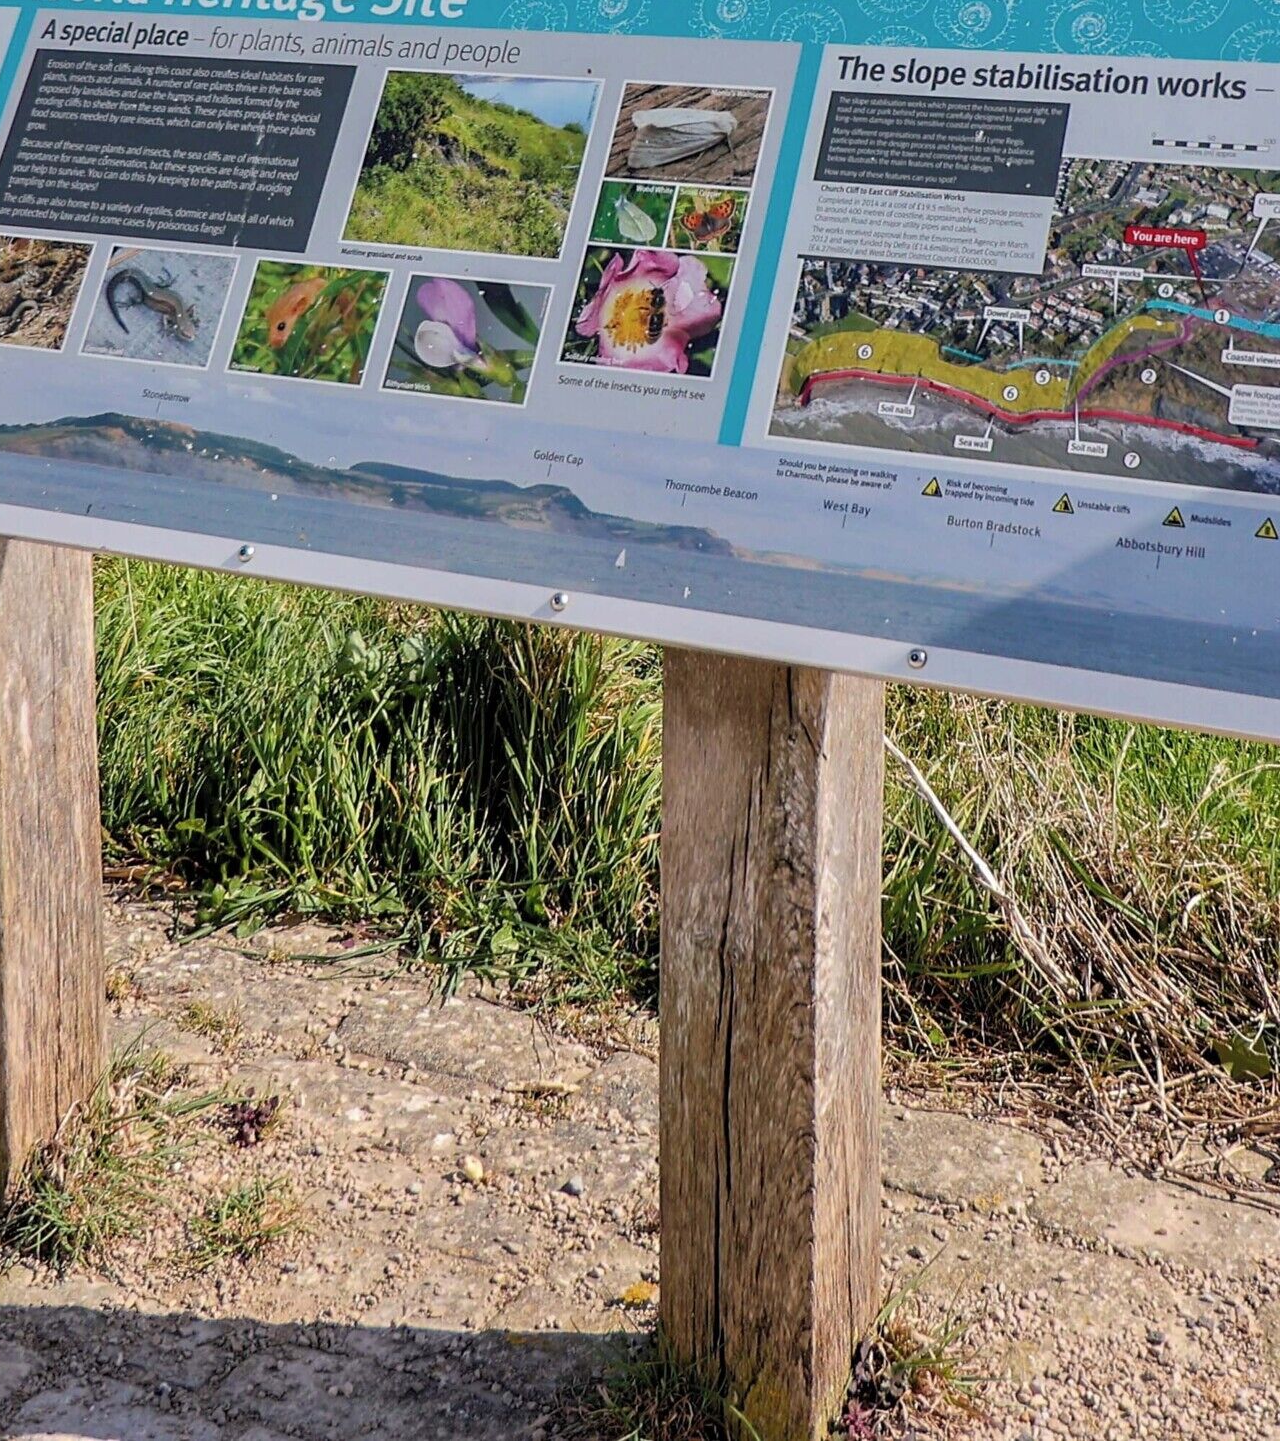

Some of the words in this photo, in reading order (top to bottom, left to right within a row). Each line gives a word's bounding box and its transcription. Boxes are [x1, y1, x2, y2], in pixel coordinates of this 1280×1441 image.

[41, 19, 57, 40] A
[60, 21, 131, 47] special
[132, 23, 188, 49] place
[206, 26, 235, 50] for
[239, 29, 304, 55] plants,
[313, 32, 392, 59] animals
[398, 37, 438, 61] and
[443, 42, 520, 67] people
[837, 56, 884, 81] The
[891, 60, 966, 91] slope
[972, 62, 1149, 95] stabilisation
[1156, 72, 1246, 100] works
[1132, 230, 1154, 243] You
[1156, 233, 1171, 243] are
[1173, 233, 1198, 245] here
[341, 248, 366, 258] Maritime
[368, 251, 394, 261] grassland
[408, 254, 423, 262] scrub
[1084, 266, 1116, 278] Drainage
[1117, 269, 1141, 278] works
[987, 308, 1009, 319] Dowel
[1010, 310, 1027, 322] piles
[1225, 353, 1255, 363] Coastal
[386, 379, 414, 390] Bithynian
[414, 382, 431, 391] Vetch
[558, 375, 583, 386] Some
[585, 378, 593, 387] of
[595, 378, 609, 389] the
[611, 381, 641, 393] insects
[643, 386, 659, 396] you
[661, 387, 687, 399] might
[690, 392, 705, 400] see
[142, 388, 191, 404] Stonebarrow
[1235, 389, 1251, 399] New
[880, 404, 894, 413] Soil
[895, 405, 912, 415] nails
[959, 438, 972, 448] Sea
[973, 439, 989, 449] wall
[1071, 442, 1085, 452] Soil
[1087, 443, 1104, 454] nails
[534, 450, 565, 464] Golden
[567, 454, 584, 467] Cap
[779, 458, 802, 469] Should
[803, 462, 817, 471] you
[818, 463, 826, 471] be
[828, 465, 858, 478] planning
[870, 470, 897, 481] walking
[785, 470, 824, 482] Charmouth,
[826, 474, 848, 485] please
[850, 478, 859, 486] be
[861, 481, 881, 489] aware
[883, 481, 892, 490] of:
[946, 479, 962, 488] Risk
[964, 480, 971, 488] of
[972, 481, 1008, 495] becoming
[665, 479, 720, 497] Thorncombe
[722, 486, 758, 501] Beacon
[945, 489, 973, 501] trapped
[975, 492, 983, 502] by
[984, 493, 1018, 506] incoming
[1020, 497, 1034, 506] tide
[823, 500, 848, 513] West
[851, 503, 870, 517] Bay
[1078, 500, 1109, 513] Unstable
[1112, 504, 1131, 515] cliffs
[947, 515, 983, 530] Burton
[986, 519, 1041, 537] Bradstock
[1191, 514, 1231, 527] Mudslides
[1116, 537, 1183, 557] Abbotsbury
[1186, 544, 1206, 558] Hill
